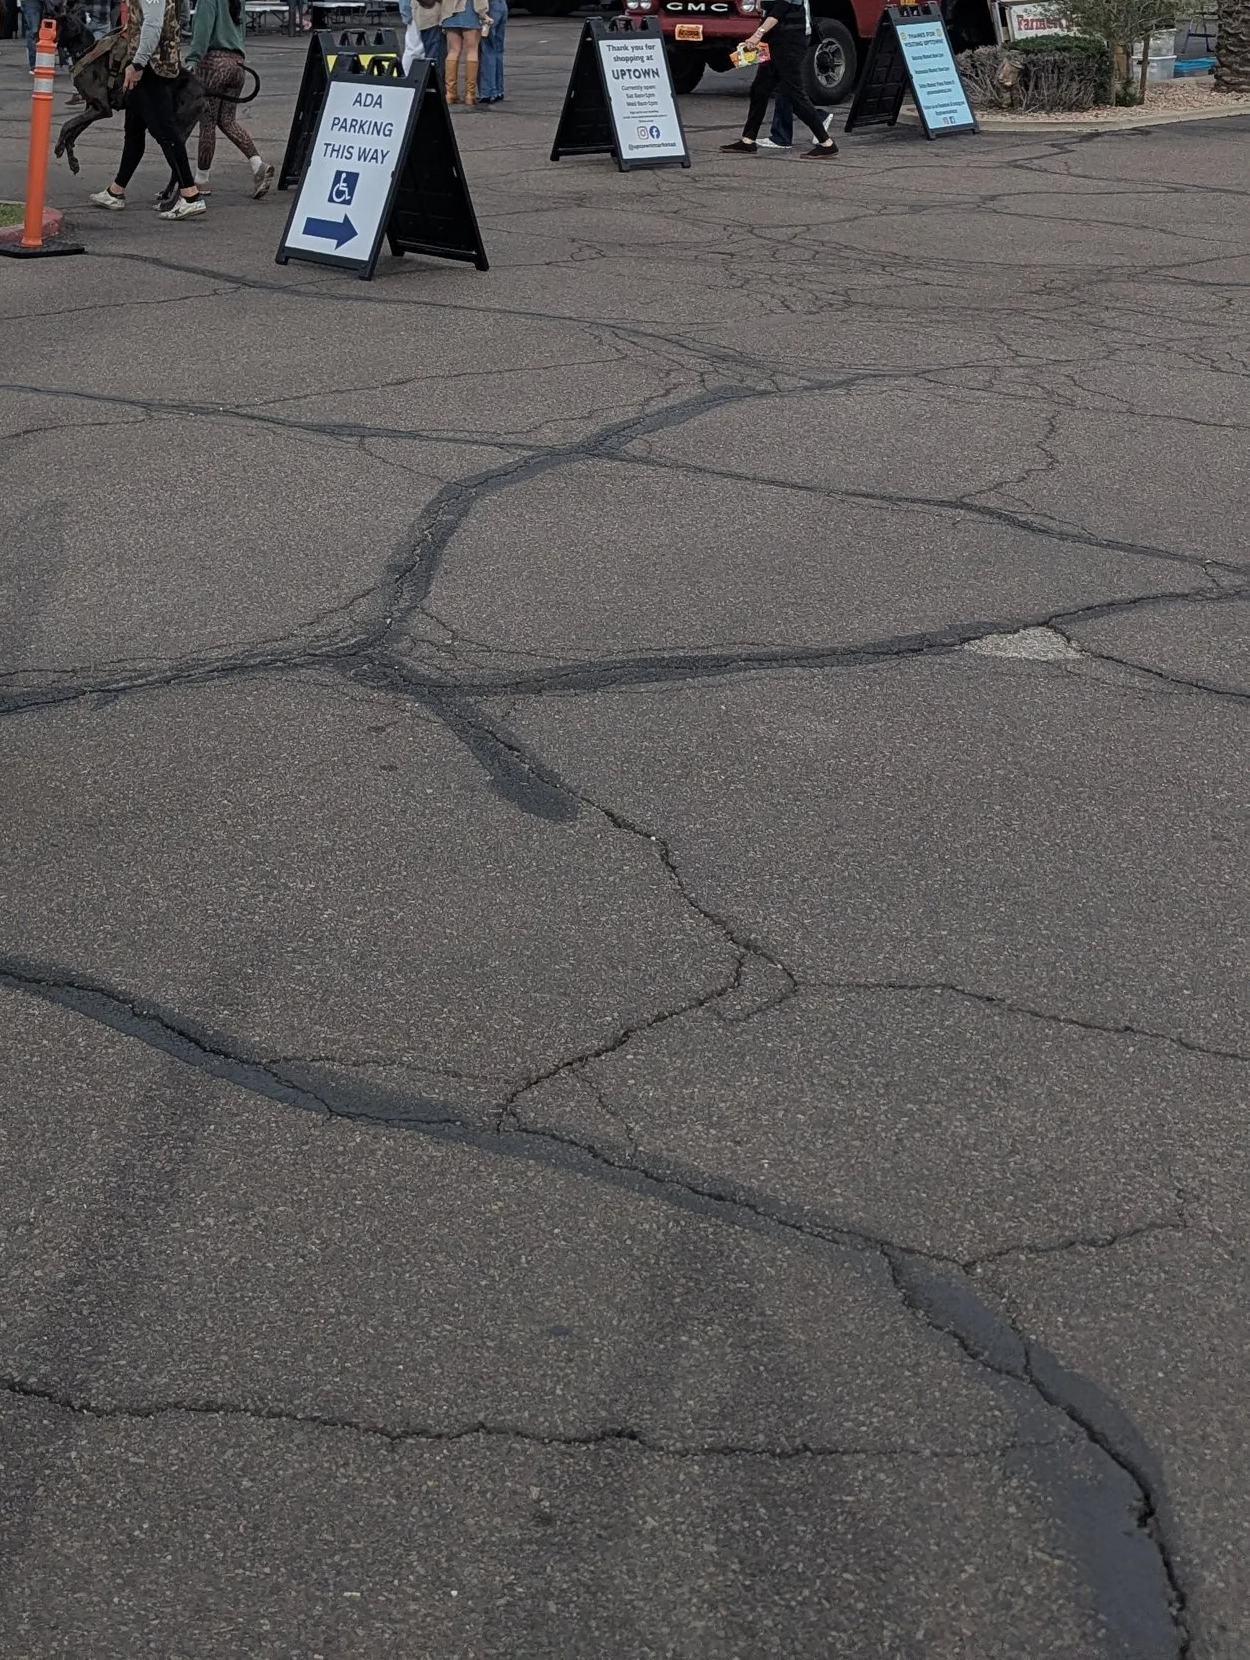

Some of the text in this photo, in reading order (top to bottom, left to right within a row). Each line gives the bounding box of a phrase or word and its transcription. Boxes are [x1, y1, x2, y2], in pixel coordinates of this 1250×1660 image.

[666, 1, 729, 12] GMC
[606, 42, 656, 53] Thank you for
[613, 53, 654, 63] shopping at
[611, 67, 661, 80] UPTOWN
[352, 91, 383, 109] ADA
[330, 116, 394, 138] PARKING
[322, 142, 390, 165] THIS WAY
